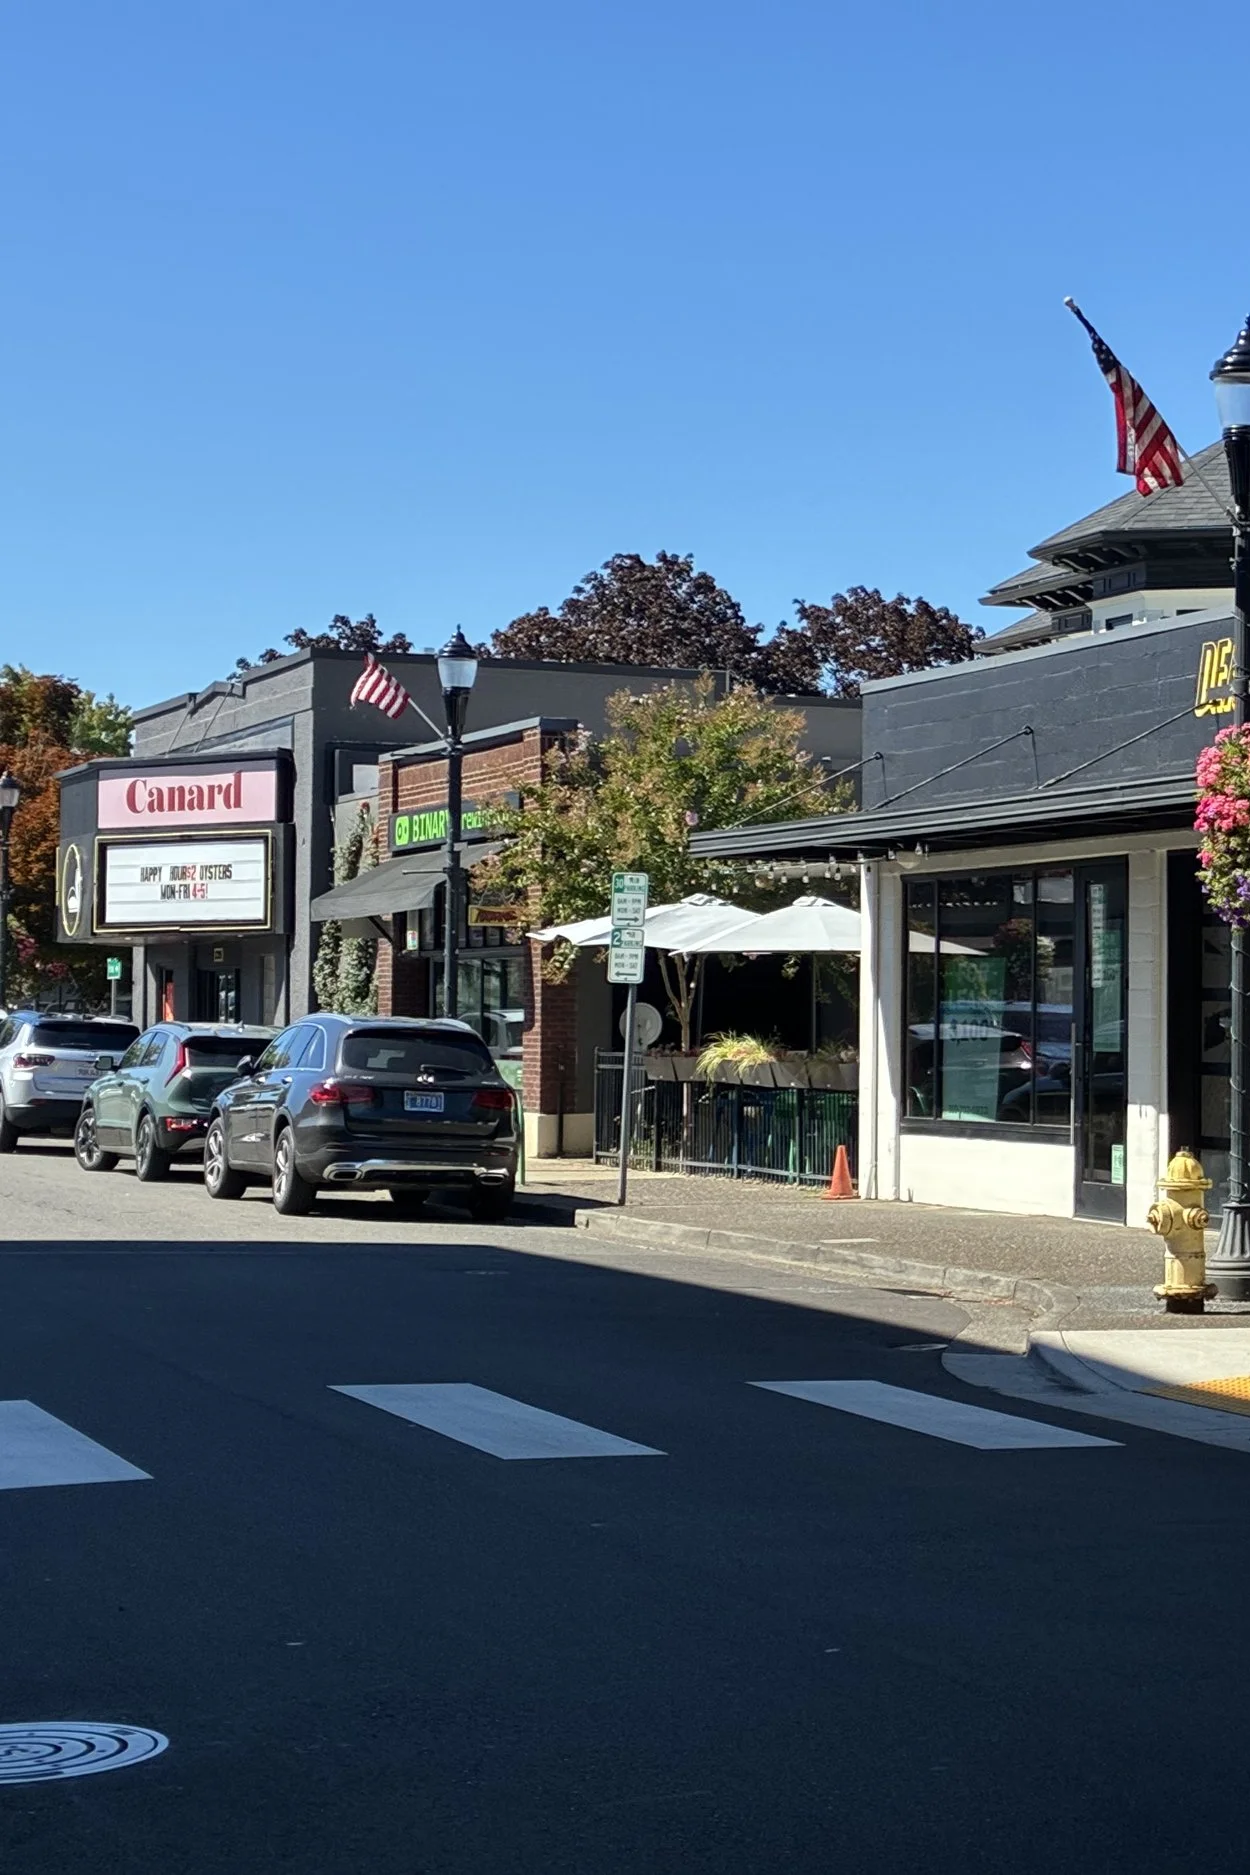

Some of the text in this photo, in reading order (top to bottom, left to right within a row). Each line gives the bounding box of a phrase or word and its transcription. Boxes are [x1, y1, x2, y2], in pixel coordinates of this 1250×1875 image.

[126, 770, 243, 814] Canard
[140, 866, 162, 882] HAPPY
[199, 864, 232, 881] OYSTERS
[160, 883, 190, 900] MON-FRI
[614, 878, 624, 889] 30
[613, 931, 621, 945] 2
